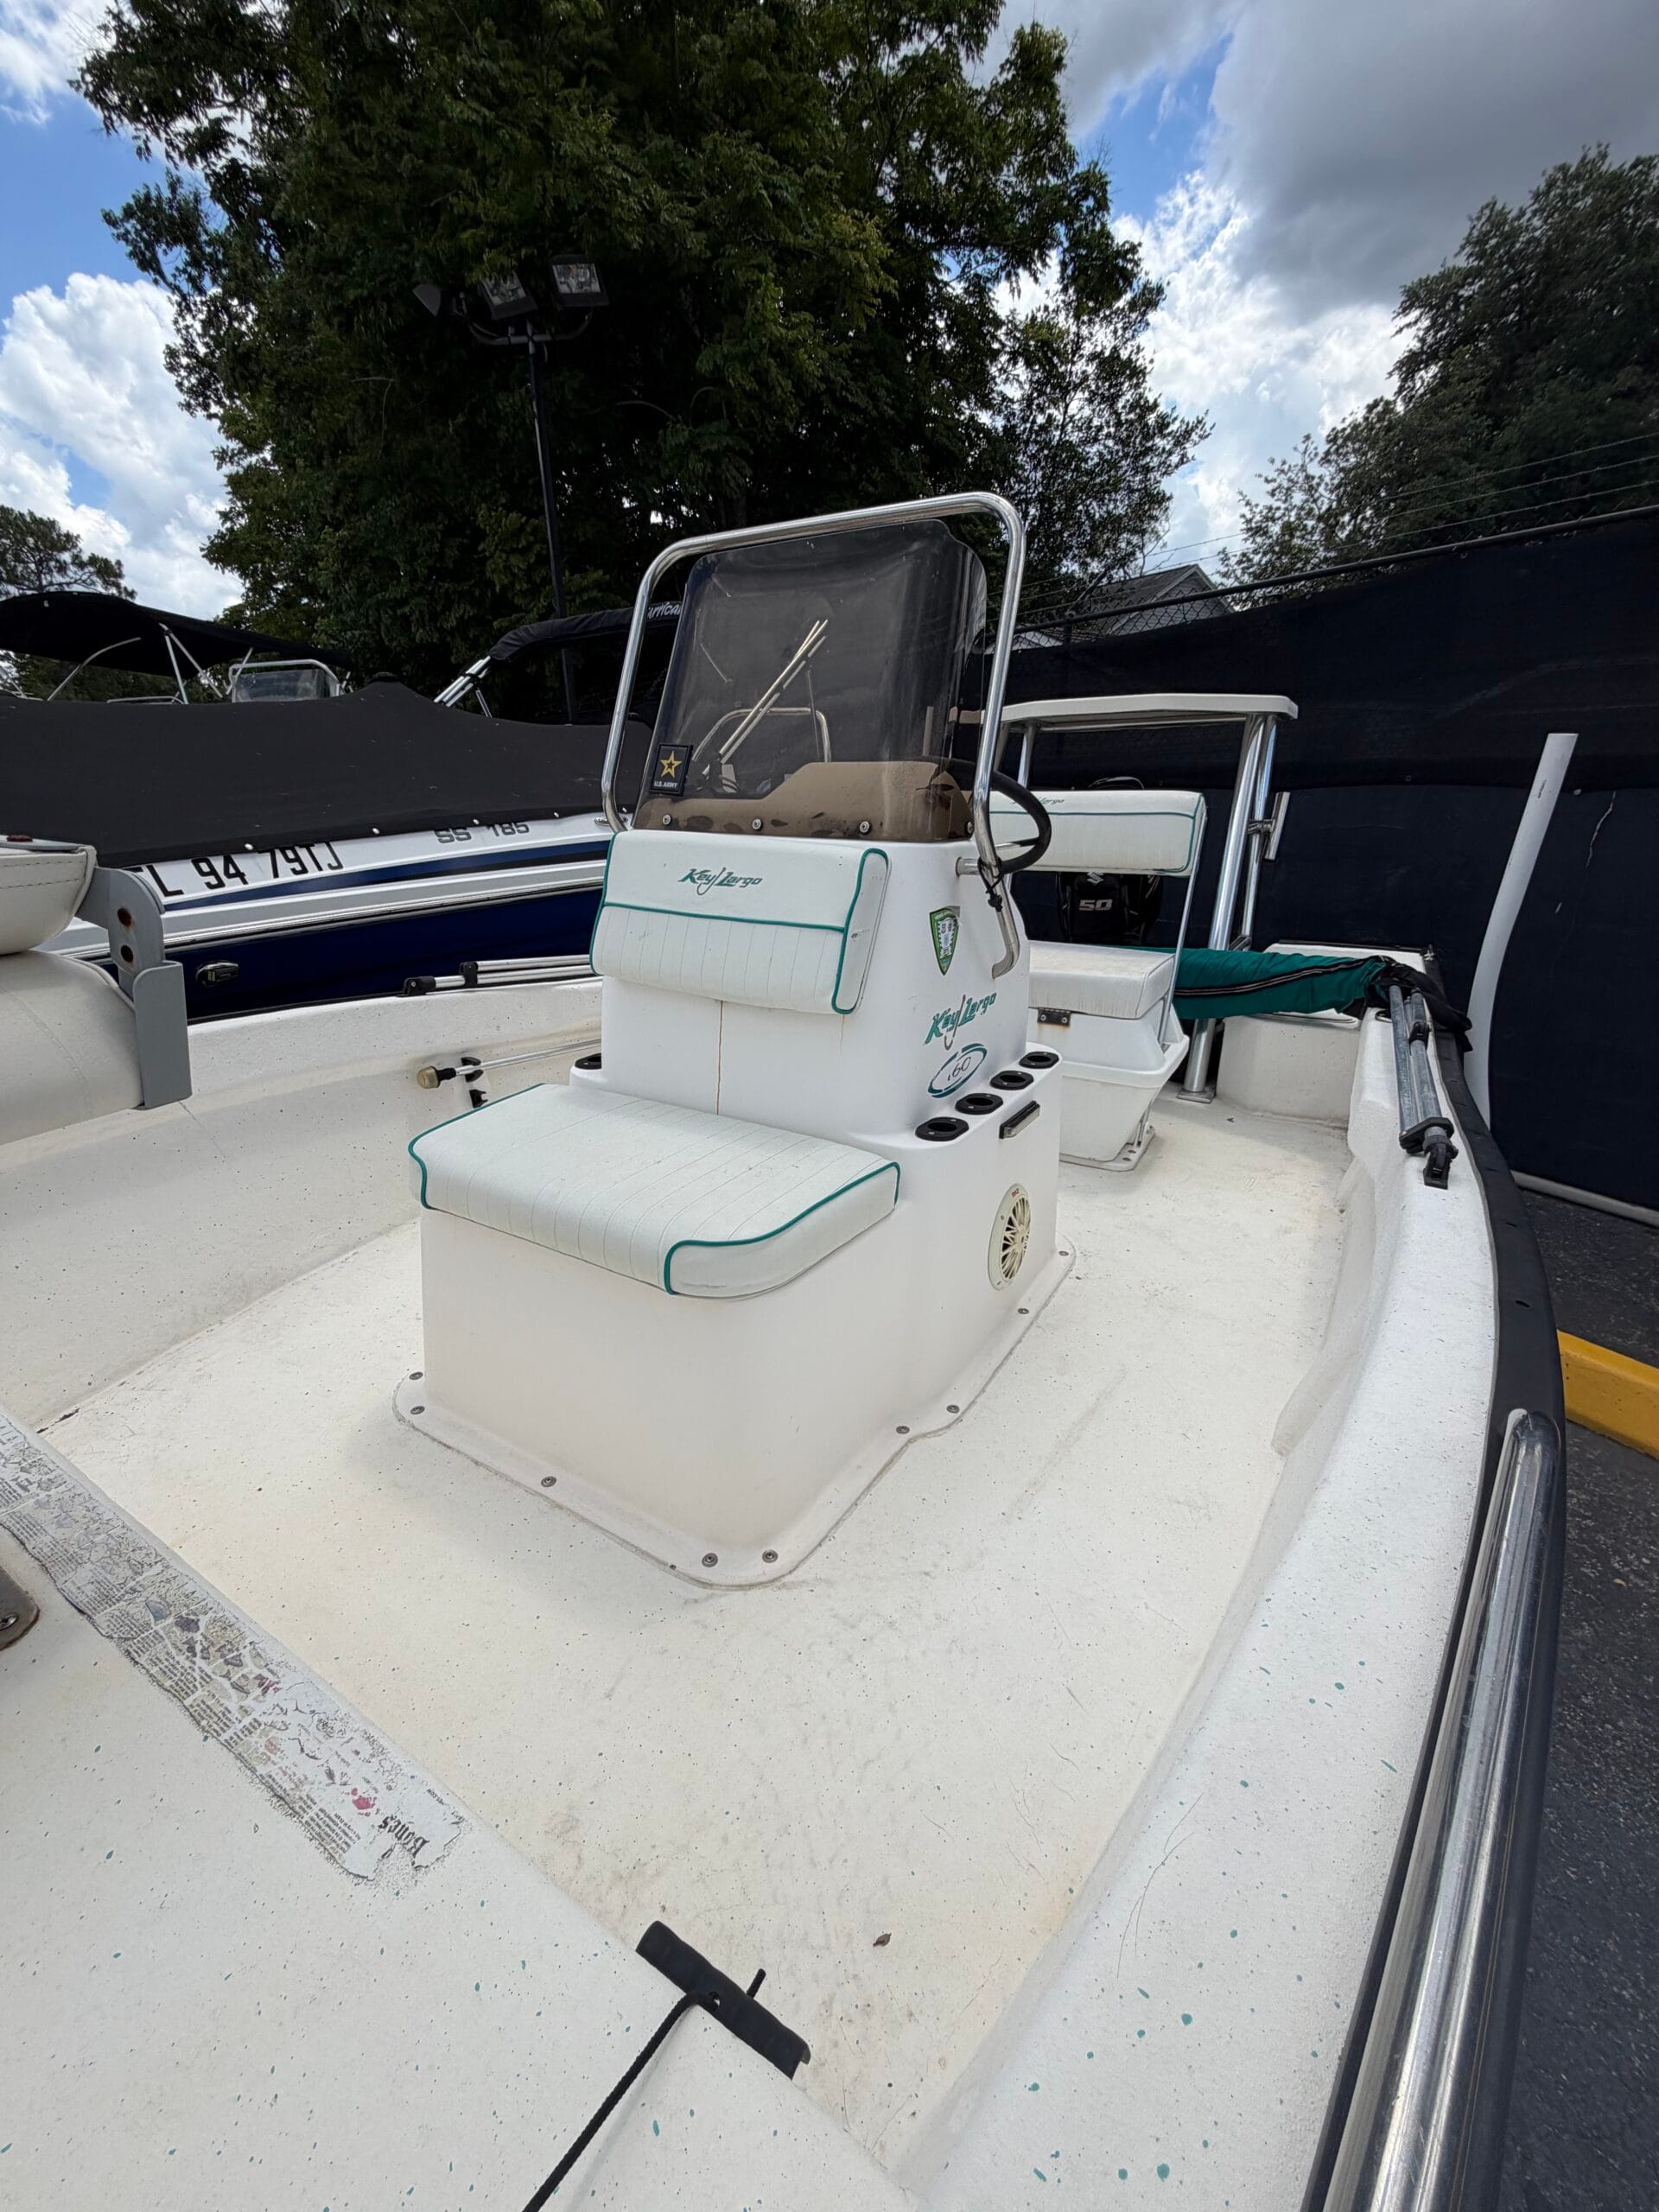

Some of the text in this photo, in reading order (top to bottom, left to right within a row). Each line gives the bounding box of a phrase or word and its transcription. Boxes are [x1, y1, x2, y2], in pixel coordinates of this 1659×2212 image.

[434, 828, 472, 843] SS
[191, 856, 249, 890] 94
[677, 868, 764, 895] Key Largo
[1079, 899, 1113, 912] 50
[924, 993, 997, 1050] Key Largo
